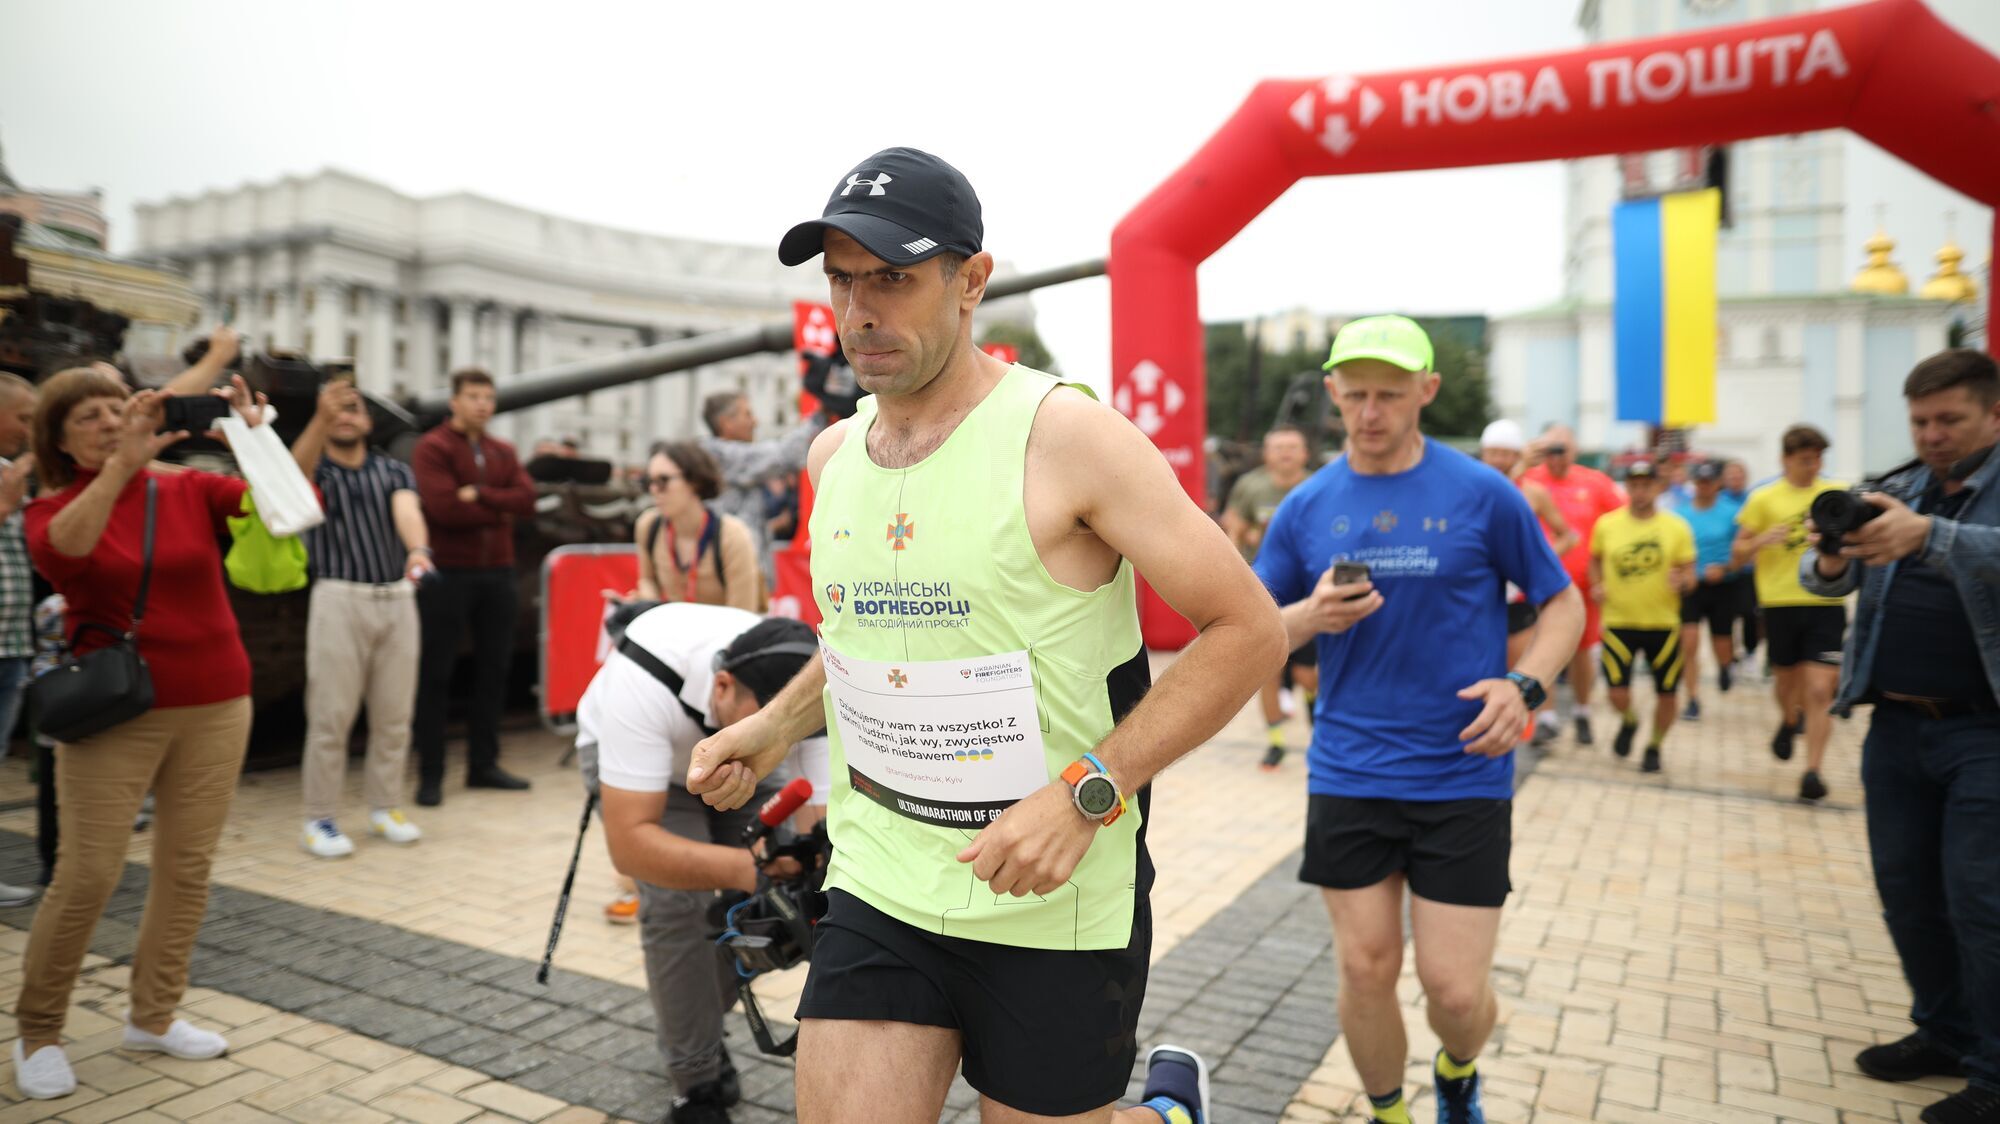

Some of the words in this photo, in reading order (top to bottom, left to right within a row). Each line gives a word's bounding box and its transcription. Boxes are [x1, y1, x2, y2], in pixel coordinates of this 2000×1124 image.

[1399, 65, 1569, 127] НОВА
[1587, 29, 1848, 108] ПОШТА
[852, 579, 951, 598] УКРАЇНСЬКІ
[854, 599, 970, 616] ВОГНЕБОРЦІ
[857, 617, 924, 629] БЛАГОДІЙНИЙ
[925, 617, 970, 629] ПРОЄКТ
[974, 663, 1011, 672] UKRAINIAN
[975, 666, 1023, 678] FIREFIGHTERS
[887, 721, 916, 731] wam
[919, 724, 934, 732] za
[937, 718, 1004, 733] wszystko!
[1007, 717, 1017, 727] Z
[862, 723, 897, 744] ludźmi,
[899, 734, 917, 746] jak
[920, 739, 941, 748] wy,
[945, 733, 1025, 748] zwycięstwo
[858, 735, 889, 753] nastąpi
[892, 747, 955, 761] niebawem
[945, 776, 963, 784] Kyiv
[897, 798, 973, 822] ULTRAMARATHON
[974, 810, 987, 822] OF
